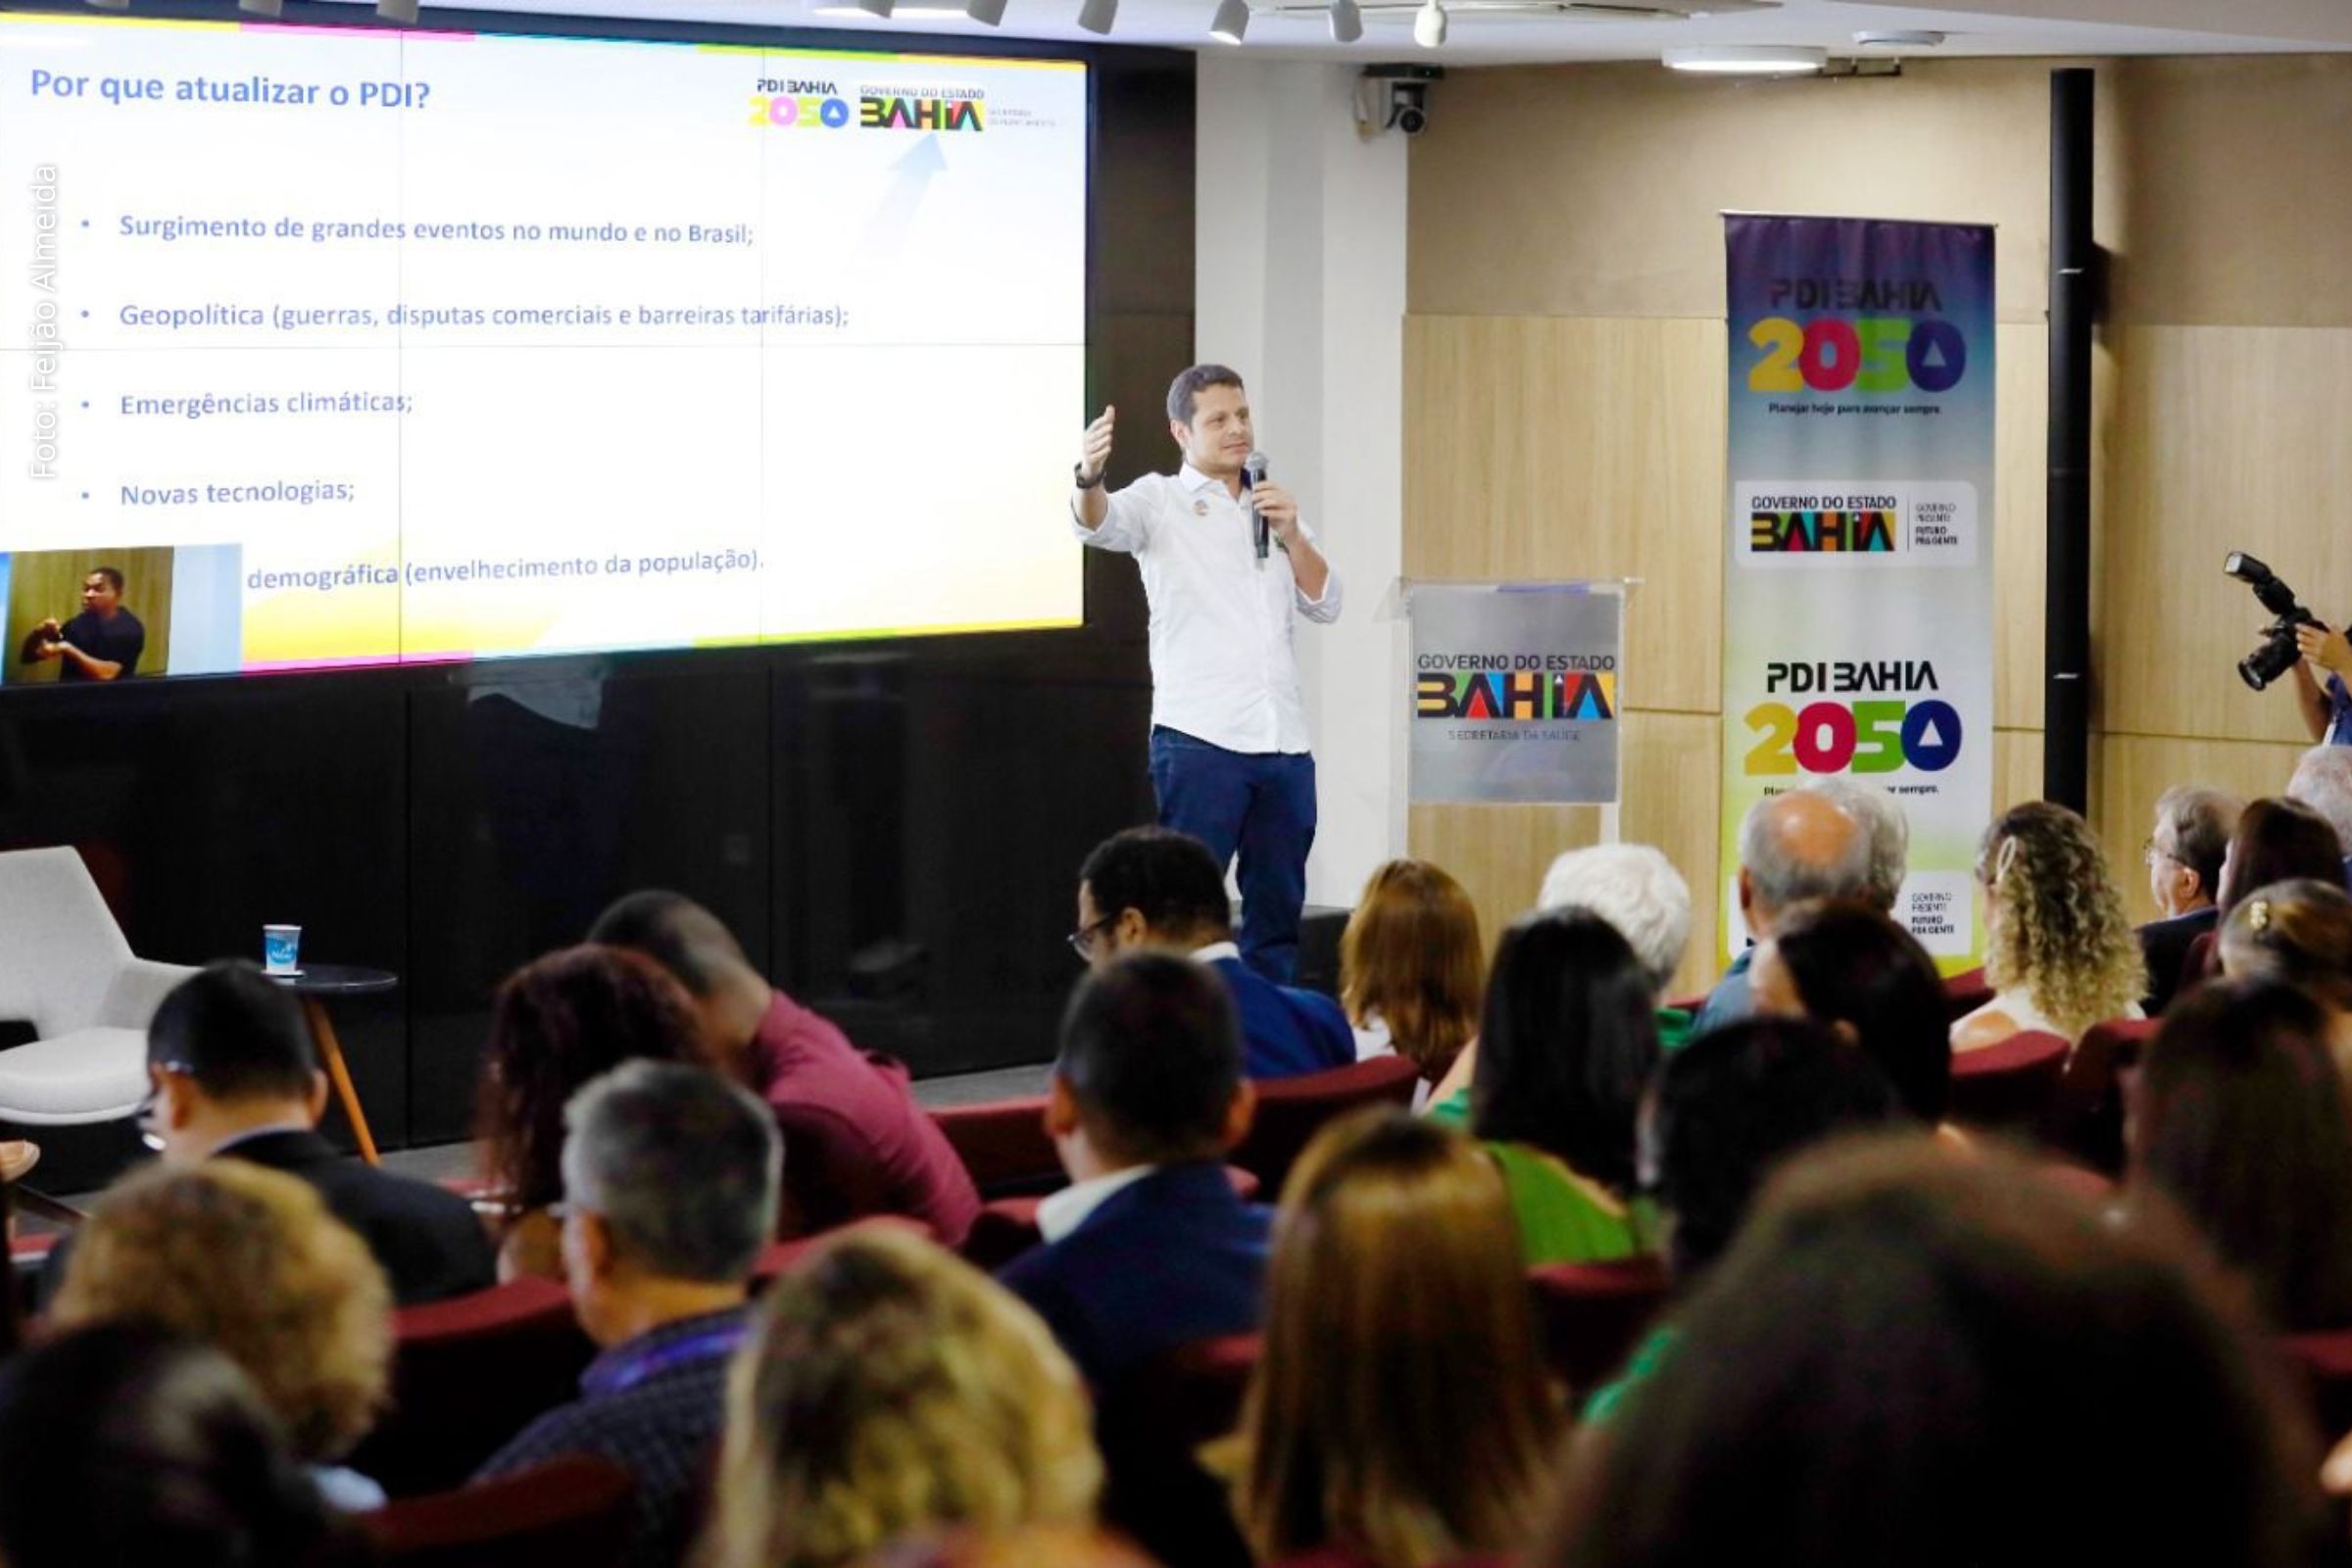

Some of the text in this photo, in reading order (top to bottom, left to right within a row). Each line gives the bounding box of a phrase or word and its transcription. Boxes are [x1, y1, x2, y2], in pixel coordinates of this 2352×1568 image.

[30, 69, 431, 110] Por que atualizar o PDI?
[757, 79, 784, 92] PDI
[859, 84, 985, 99] GOVERNO DO ESTADO
[747, 95, 850, 128] 2050
[119, 215, 755, 248] Surgimento de grandes eventos no mundo e no Brasil;
[1770, 278, 1829, 310] PDI
[120, 302, 851, 330] Geopolítica (guerras, disputas comerciais e barreiras tarifárias);
[1748, 318, 1966, 393] 2050
[120, 390, 414, 420] Emergências climáticas;
[1768, 402, 1810, 416] Planejar
[121, 479, 355, 506] Novas tecnologias;
[1750, 495, 1897, 511] GOVERNO DO ESTADO
[247, 548, 764, 593] demográfica (envelhecimento da população).
[1417, 654, 1616, 671] GOVERNO DO ESTADO
[1766, 662, 1827, 693] PDI
[1743, 699, 1963, 775] 2050
